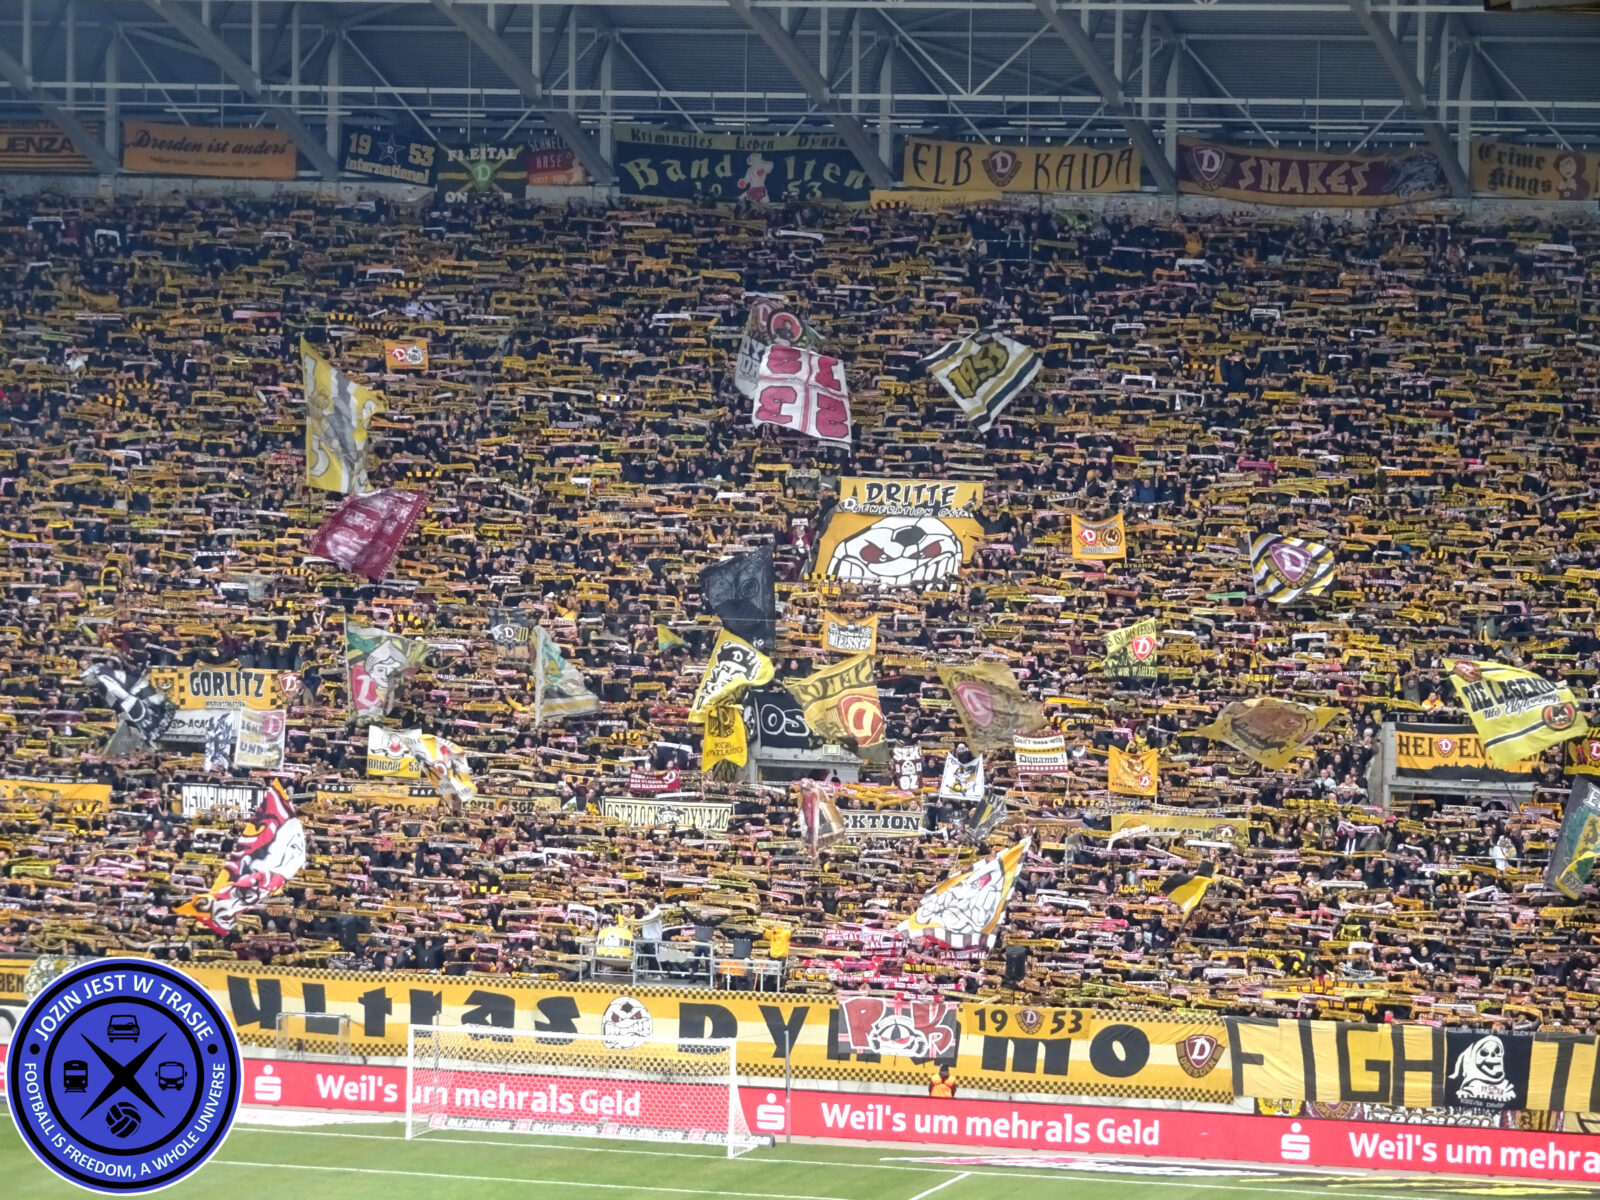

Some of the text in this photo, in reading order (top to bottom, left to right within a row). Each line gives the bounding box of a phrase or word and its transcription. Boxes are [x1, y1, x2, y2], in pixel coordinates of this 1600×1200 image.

[209, 137, 230, 152] ist
[350, 132, 372, 154] 19
[408, 143, 436, 167] 53
[913, 143, 971, 186] ELB
[1034, 148, 1135, 190] KAIDA
[1238, 157, 1370, 196] SNAKES
[866, 482, 956, 508] DRITTE
[853, 504, 933, 517] GENERATION
[1018, 754, 1059, 766] Dynamo
[606, 802, 731, 832] OSTBLOCK DYNAMO
[843, 814, 921, 831] EKTION
[974, 1008, 1009, 1032] 19
[1050, 1009, 1083, 1035] 53
[1179, 1055, 1218, 1079] DRESDEN
[316, 1074, 399, 1103] Weil's
[455, 1083, 531, 1109] mehr
[531, 1084, 575, 1115] als
[580, 1089, 641, 1117] Geld
[821, 1102, 1160, 1146] Weil's um mehr als Geld
[1348, 1130, 1438, 1164] Weil's
[1446, 1143, 1493, 1166] um
[1500, 1141, 1581, 1172] mehr
